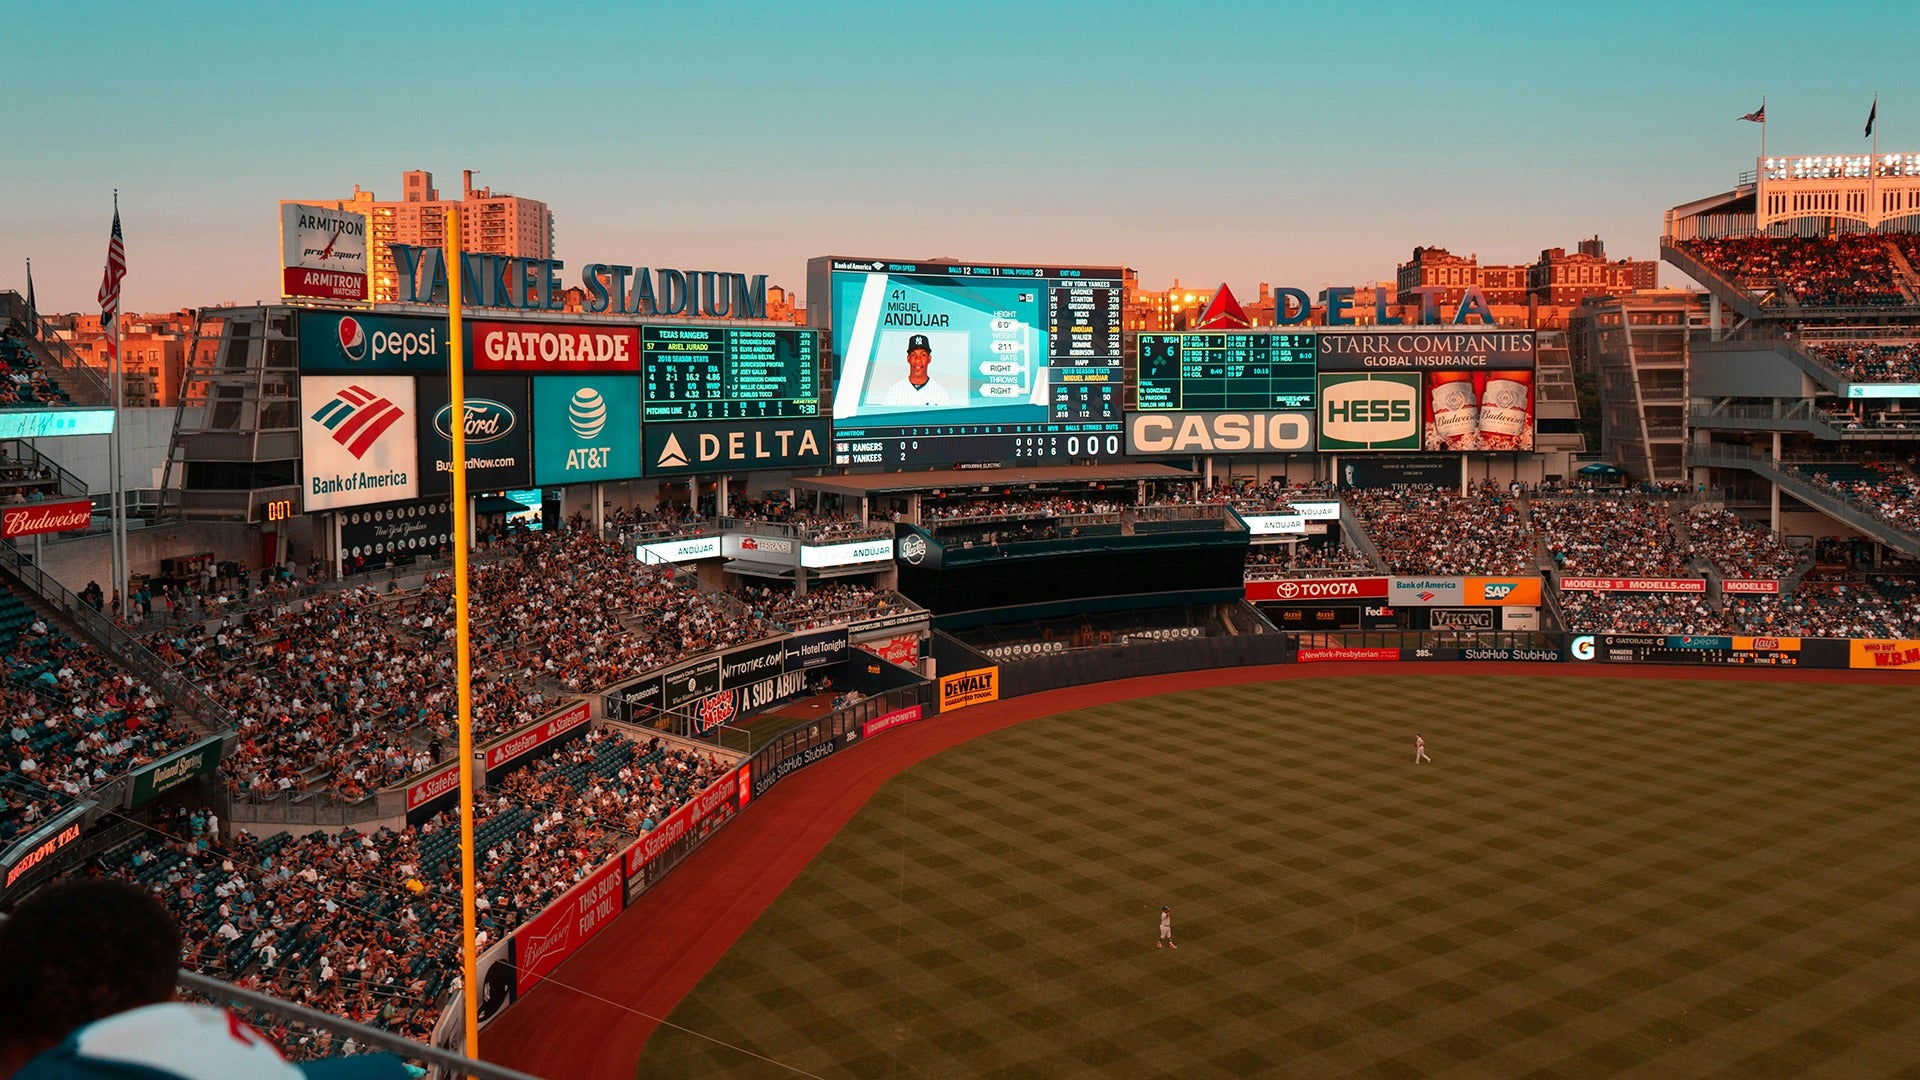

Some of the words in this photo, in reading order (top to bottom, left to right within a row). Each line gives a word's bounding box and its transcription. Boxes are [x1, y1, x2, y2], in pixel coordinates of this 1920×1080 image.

[298, 214, 364, 236] ARMITRON
[852, 263, 872, 271] America
[963, 266, 971, 274] 12
[992, 268, 1000, 276] 11
[1035, 269, 1044, 277] 23
[303, 271, 362, 289] ARMITRON
[388, 243, 564, 311] YANKEE
[582, 263, 769, 319] STADIUM
[332, 287, 361, 297] WATCHES
[892, 290, 906, 300] 41
[888, 302, 918, 312] MIGUEL
[1274, 286, 1496, 326] DELTA
[680, 332, 709, 340] RANGERS
[1321, 336, 1391, 354] STARR
[1398, 334, 1533, 354] COMPANIES
[372, 327, 436, 362] pepsi
[485, 331, 630, 362] GATORADE
[1144, 347, 1151, 357] 3
[1167, 347, 1174, 356] 6
[1364, 355, 1404, 367] GLOBAL
[1406, 354, 1487, 366] INSURANCE
[686, 374, 700, 382] 16.2
[646, 406, 670, 416] PITCHING
[670, 406, 682, 414] LINE
[1328, 400, 1411, 423] HESS
[1133, 414, 1310, 452] CASIO
[700, 429, 820, 462] DELTA
[852, 442, 883, 452] RANGERS
[1068, 436, 1080, 456] 0
[1086, 436, 1098, 455] 0
[1106, 436, 1118, 454] 0
[566, 448, 611, 470] AT&T
[852, 454, 883, 462] YANKEES
[900, 453, 906, 461] 2
[1016, 448, 1021, 456] 2
[1026, 448, 1032, 456] 2
[436, 457, 515, 472] BuyrdNow.com
[312, 474, 343, 495] Bank
[344, 473, 358, 492] of
[358, 471, 408, 490] America
[1392, 482, 1409, 490] THE
[268, 500, 291, 521] 0:07
[4, 510, 91, 535] Budweiser
[374, 526, 389, 536] New
[404, 521, 427, 537] Yankees
[1301, 582, 1359, 596] TOYOTA
[1396, 580, 1416, 589] Bank
[1416, 580, 1424, 588] of
[1424, 580, 1456, 589] America
[1485, 584, 1511, 598] SAP
[1564, 580, 1611, 589] MODELL'S
[1629, 580, 1701, 590] MODELLS.com
[1727, 582, 1774, 591] MODELL'S
[1365, 606, 1394, 616] FedEx
[1434, 611, 1490, 626] VIKING
[1465, 650, 1509, 660] StubHub
[1512, 650, 1558, 661] StubHub
[1864, 644, 1880, 652] WHO
[722, 650, 782, 680] NITTOTIRE.COM
[626, 684, 660, 704] Panasonic
[742, 688, 750, 712] A
[752, 679, 774, 708] SUB
[776, 669, 808, 700] ABOVE
[700, 690, 733, 716] Jersey
[945, 695, 973, 707] GUARANTEED
[703, 707, 734, 732] Mike's
[890, 710, 917, 725] DONUTS
[152, 760, 180, 788] Poland
[180, 752, 204, 776] Spring
[756, 776, 777, 796] StubHub
[776, 754, 802, 778] StubHub
[804, 742, 834, 763] StubHub
[6, 836, 58, 888] BIGELOW
[58, 824, 80, 848] TEA
[579, 886, 597, 914] THIS
[598, 868, 620, 899] BUD'S
[580, 910, 594, 936] FOR
[526, 924, 570, 968] Budweiser
